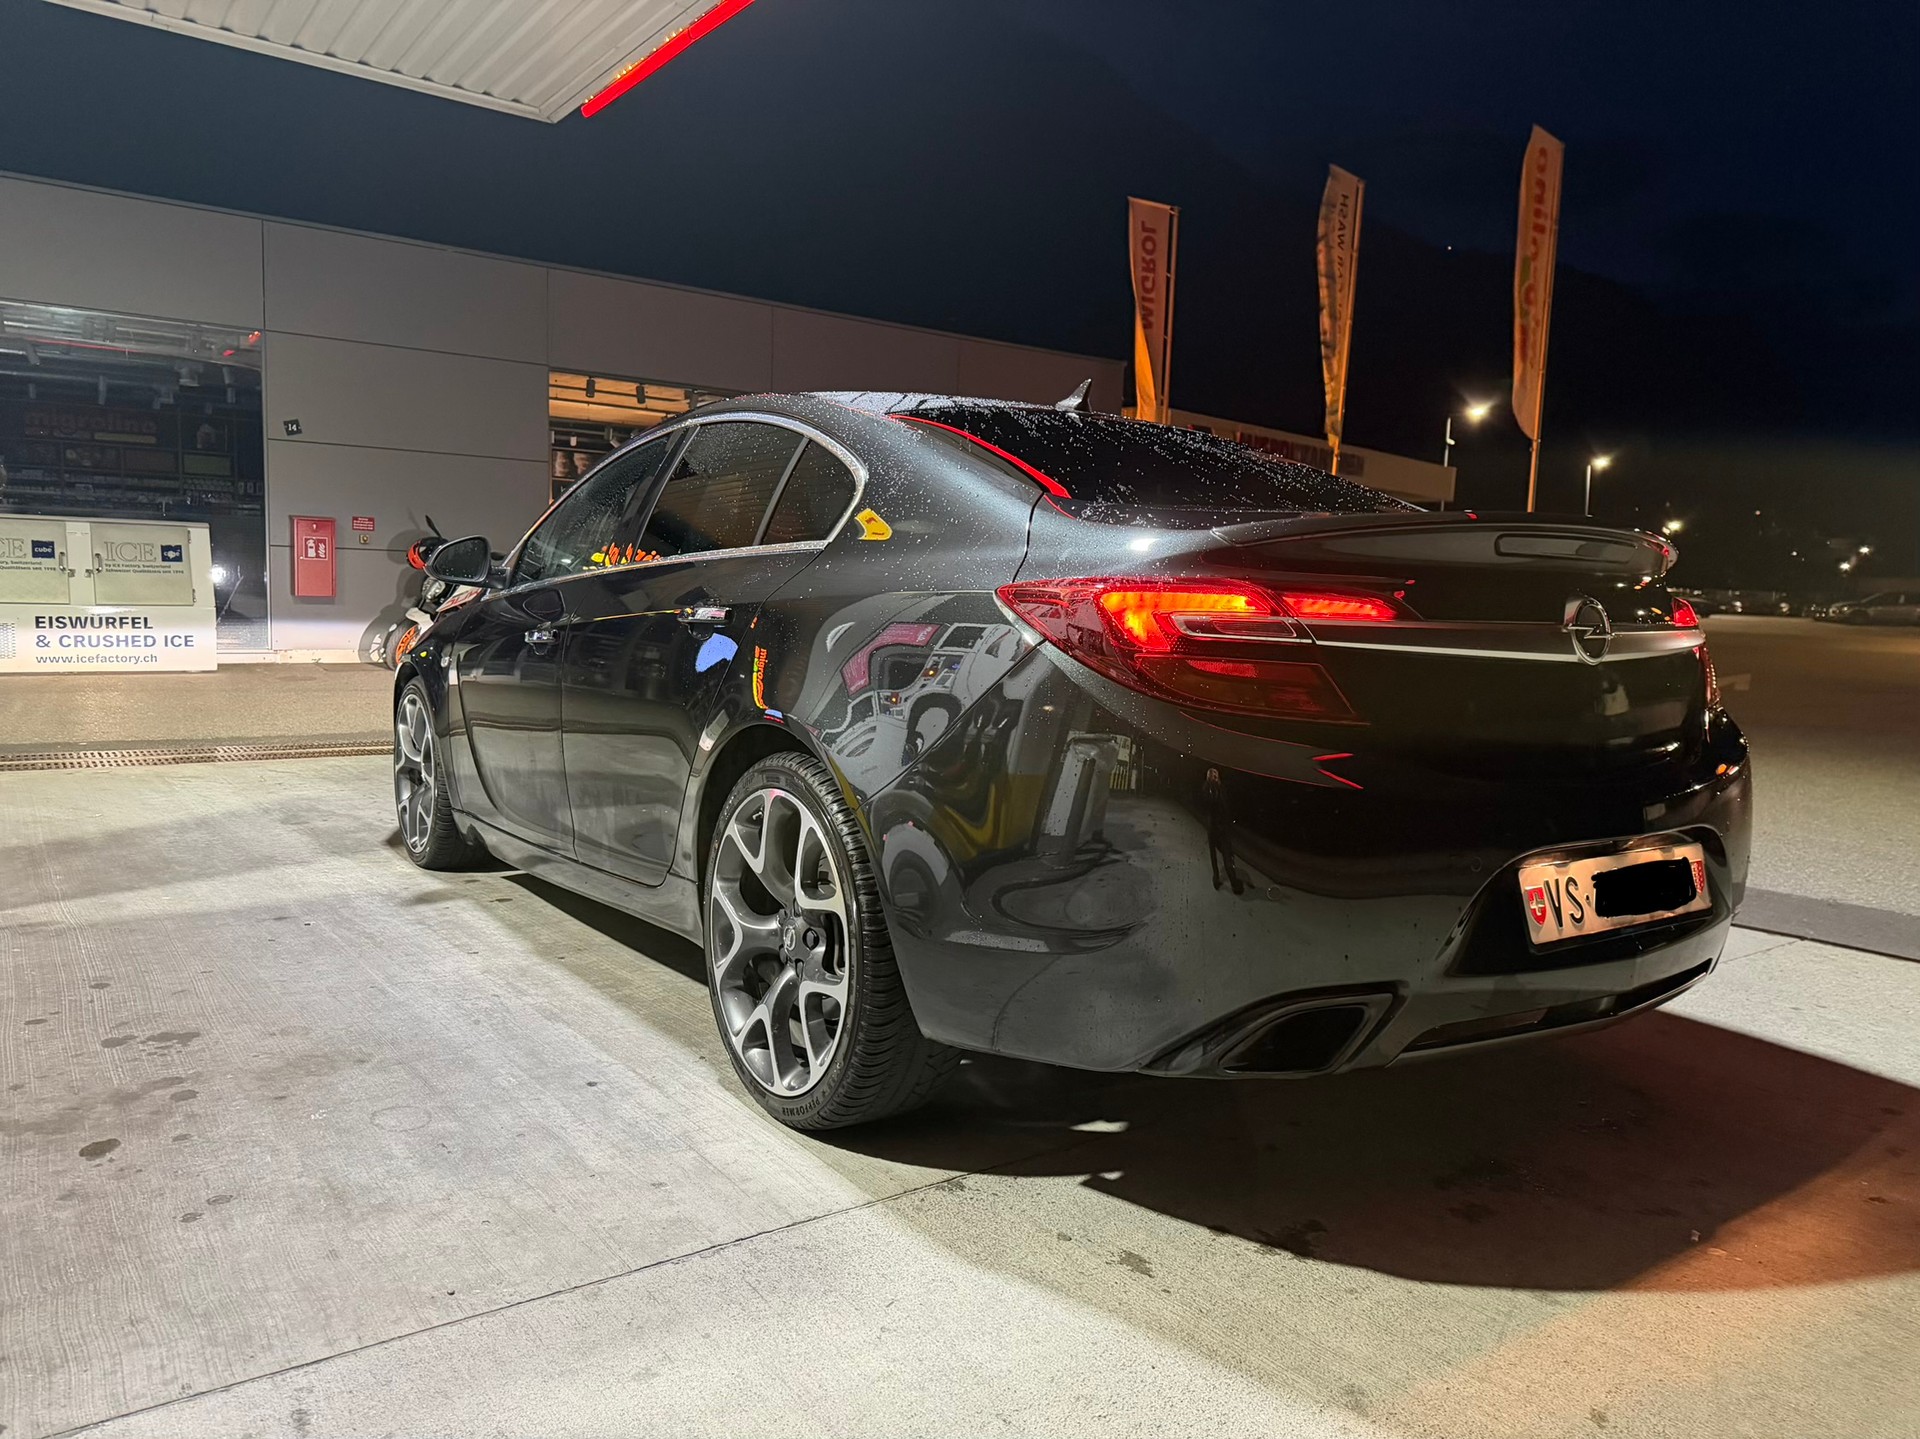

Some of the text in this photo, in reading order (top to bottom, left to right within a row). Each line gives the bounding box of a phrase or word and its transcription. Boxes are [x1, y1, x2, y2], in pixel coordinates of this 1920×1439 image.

[104, 541, 157, 562] ICE
[35, 613, 154, 629] EISWÜRFEL
[35, 634, 195, 648] & CRUSHED ICE
[36, 653, 158, 665] www.icefactory.ch
[782, 1097, 821, 1117] PERFORMER
